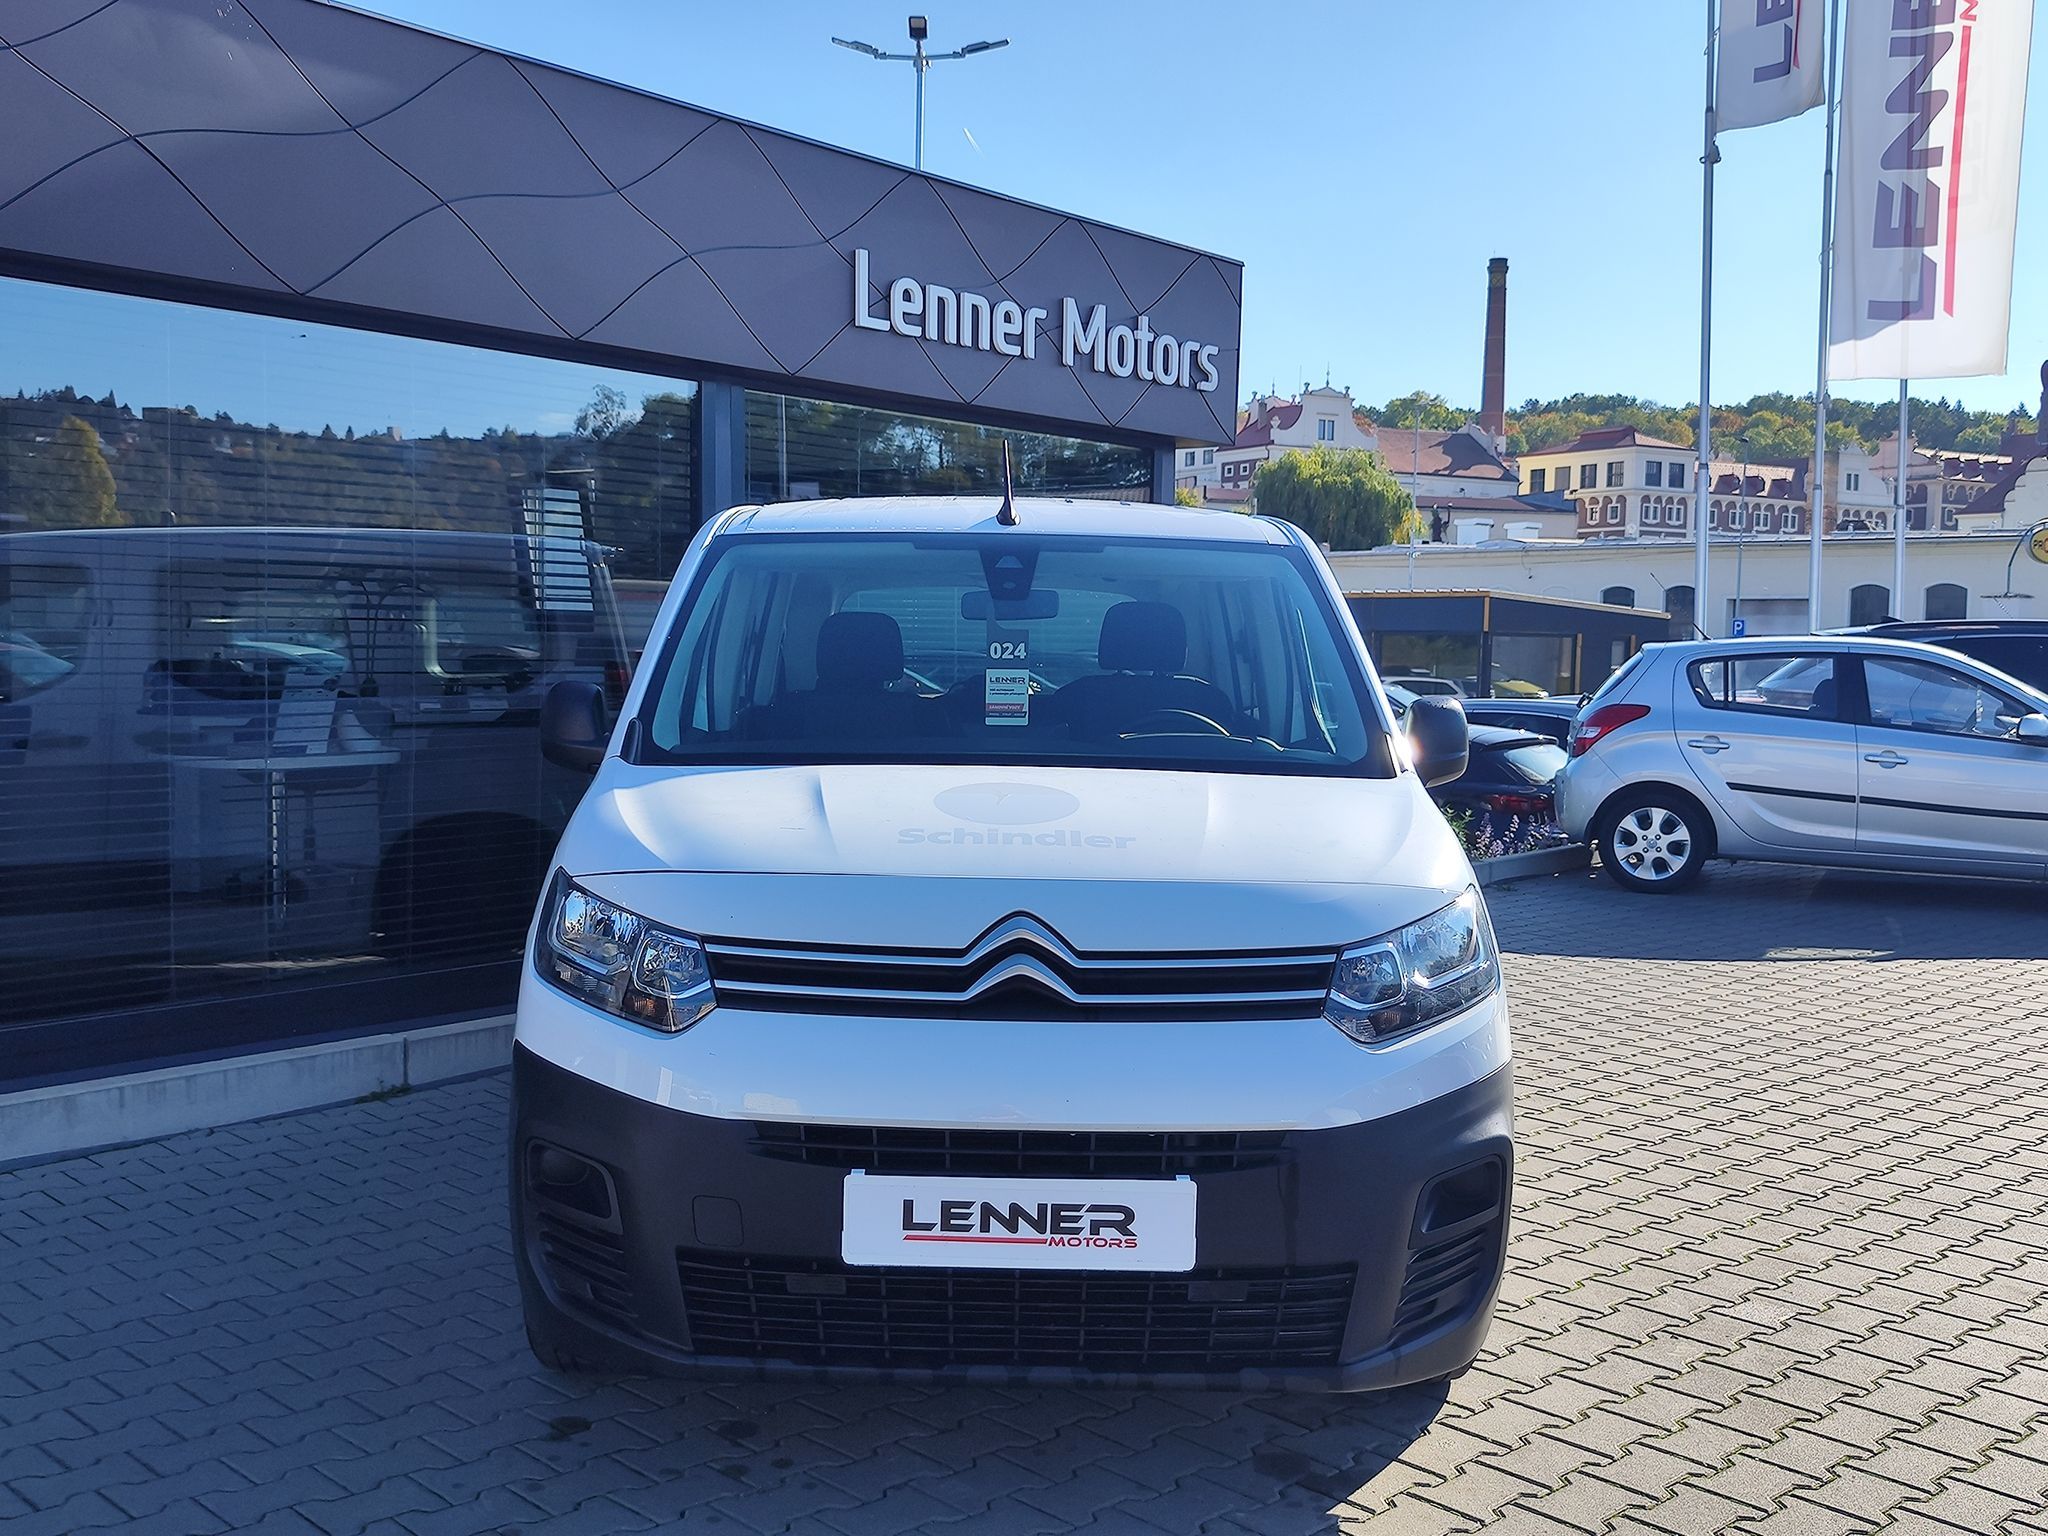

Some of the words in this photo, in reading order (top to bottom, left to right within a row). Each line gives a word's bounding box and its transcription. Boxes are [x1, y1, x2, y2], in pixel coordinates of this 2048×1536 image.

[854, 248, 1048, 360] Lenner
[1061, 296, 1220, 393] Motors
[1734, 621, 1743, 635] P
[989, 642, 1027, 659] 024
[896, 827, 1137, 849] Schindler
[902, 1199, 1138, 1237] LENNER
[1048, 1236, 1138, 1249] MOTORS
